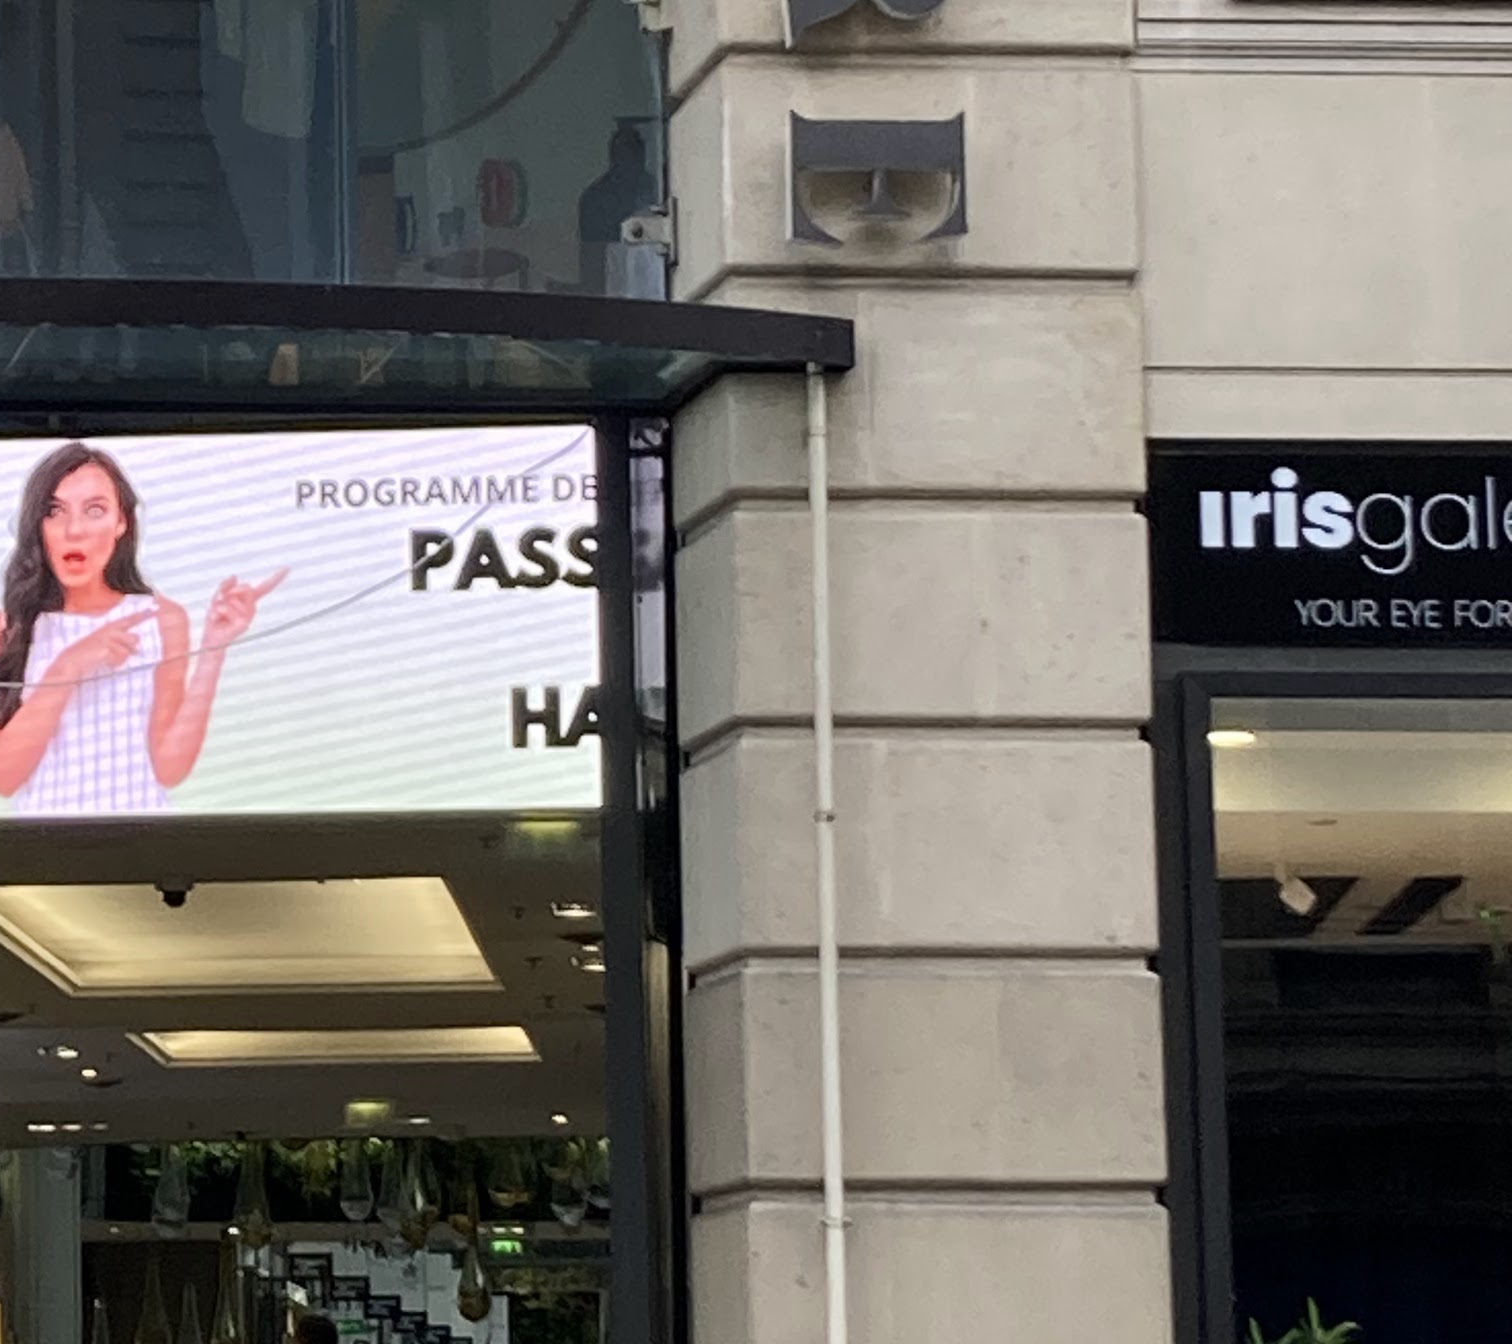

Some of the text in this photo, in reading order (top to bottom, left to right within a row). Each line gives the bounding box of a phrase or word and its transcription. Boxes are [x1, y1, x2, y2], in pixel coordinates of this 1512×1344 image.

[295, 474, 541, 509] PROGRAMME
[1199, 467, 1512, 575] irisgal
[409, 526, 600, 591] PASS
[1294, 599, 1512, 628] YOUR EYE FOR
[511, 685, 602, 748] HA
